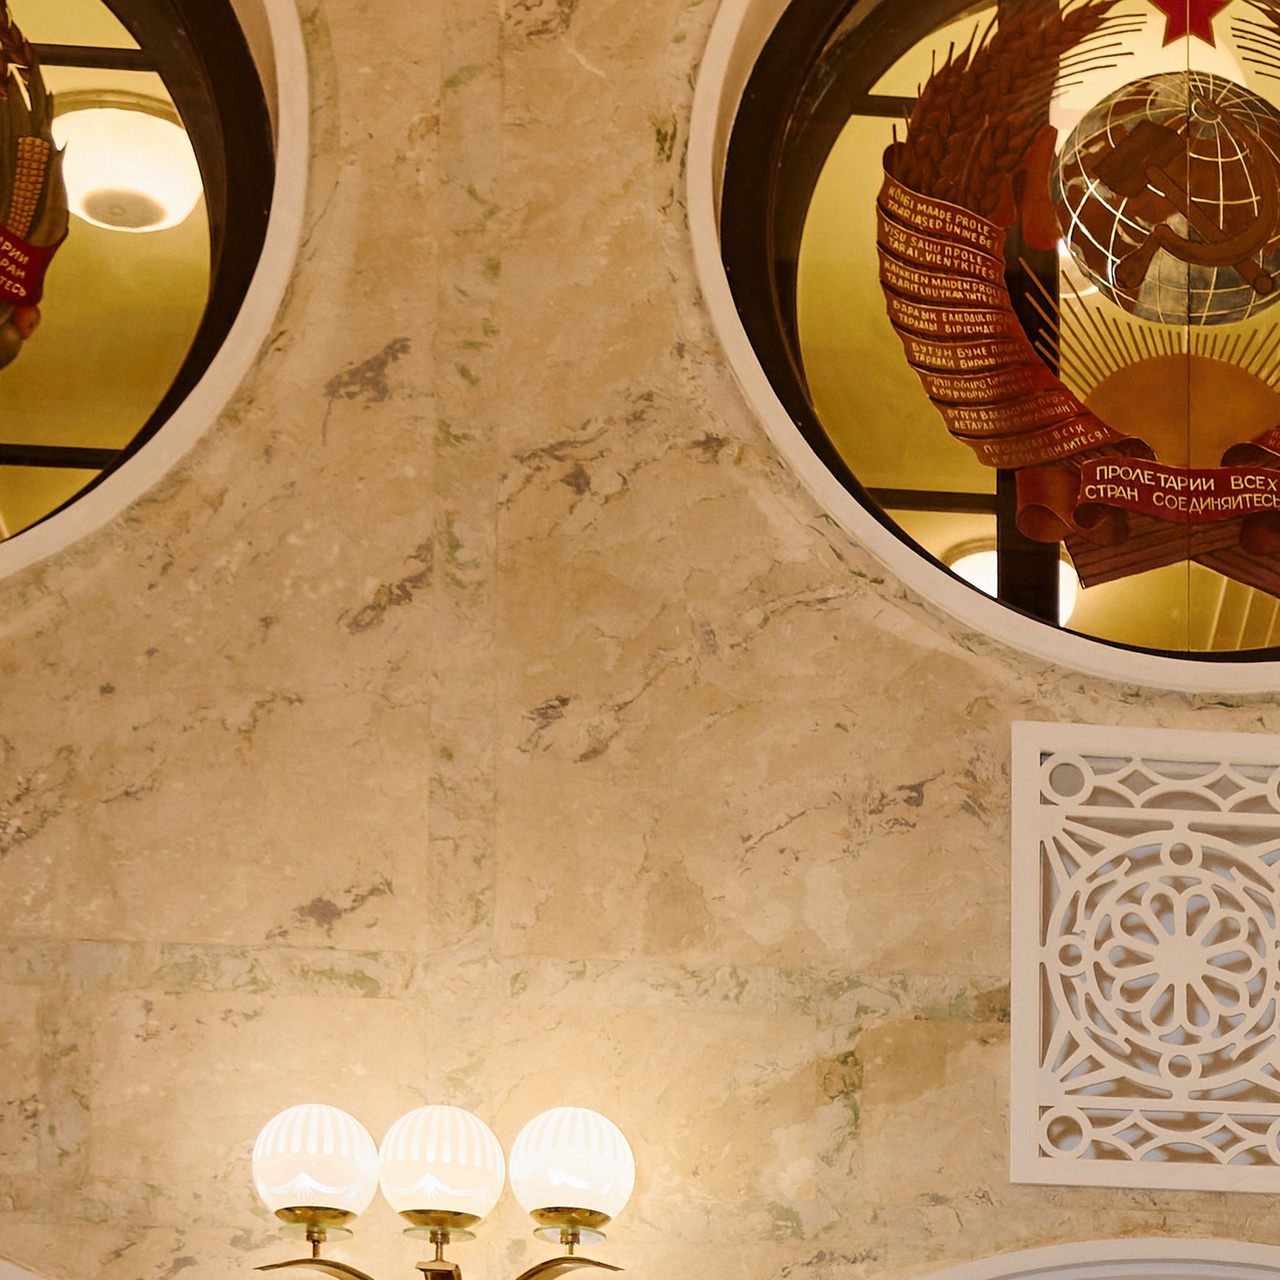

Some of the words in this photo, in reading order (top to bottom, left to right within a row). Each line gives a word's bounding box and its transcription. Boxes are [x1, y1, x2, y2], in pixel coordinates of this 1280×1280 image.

[1096, 465, 1215, 491] ПРОЛЕТАРИИ
[1230, 475, 1279, 492] ВСЕХ
[1085, 485, 1140, 502] СТРАН
